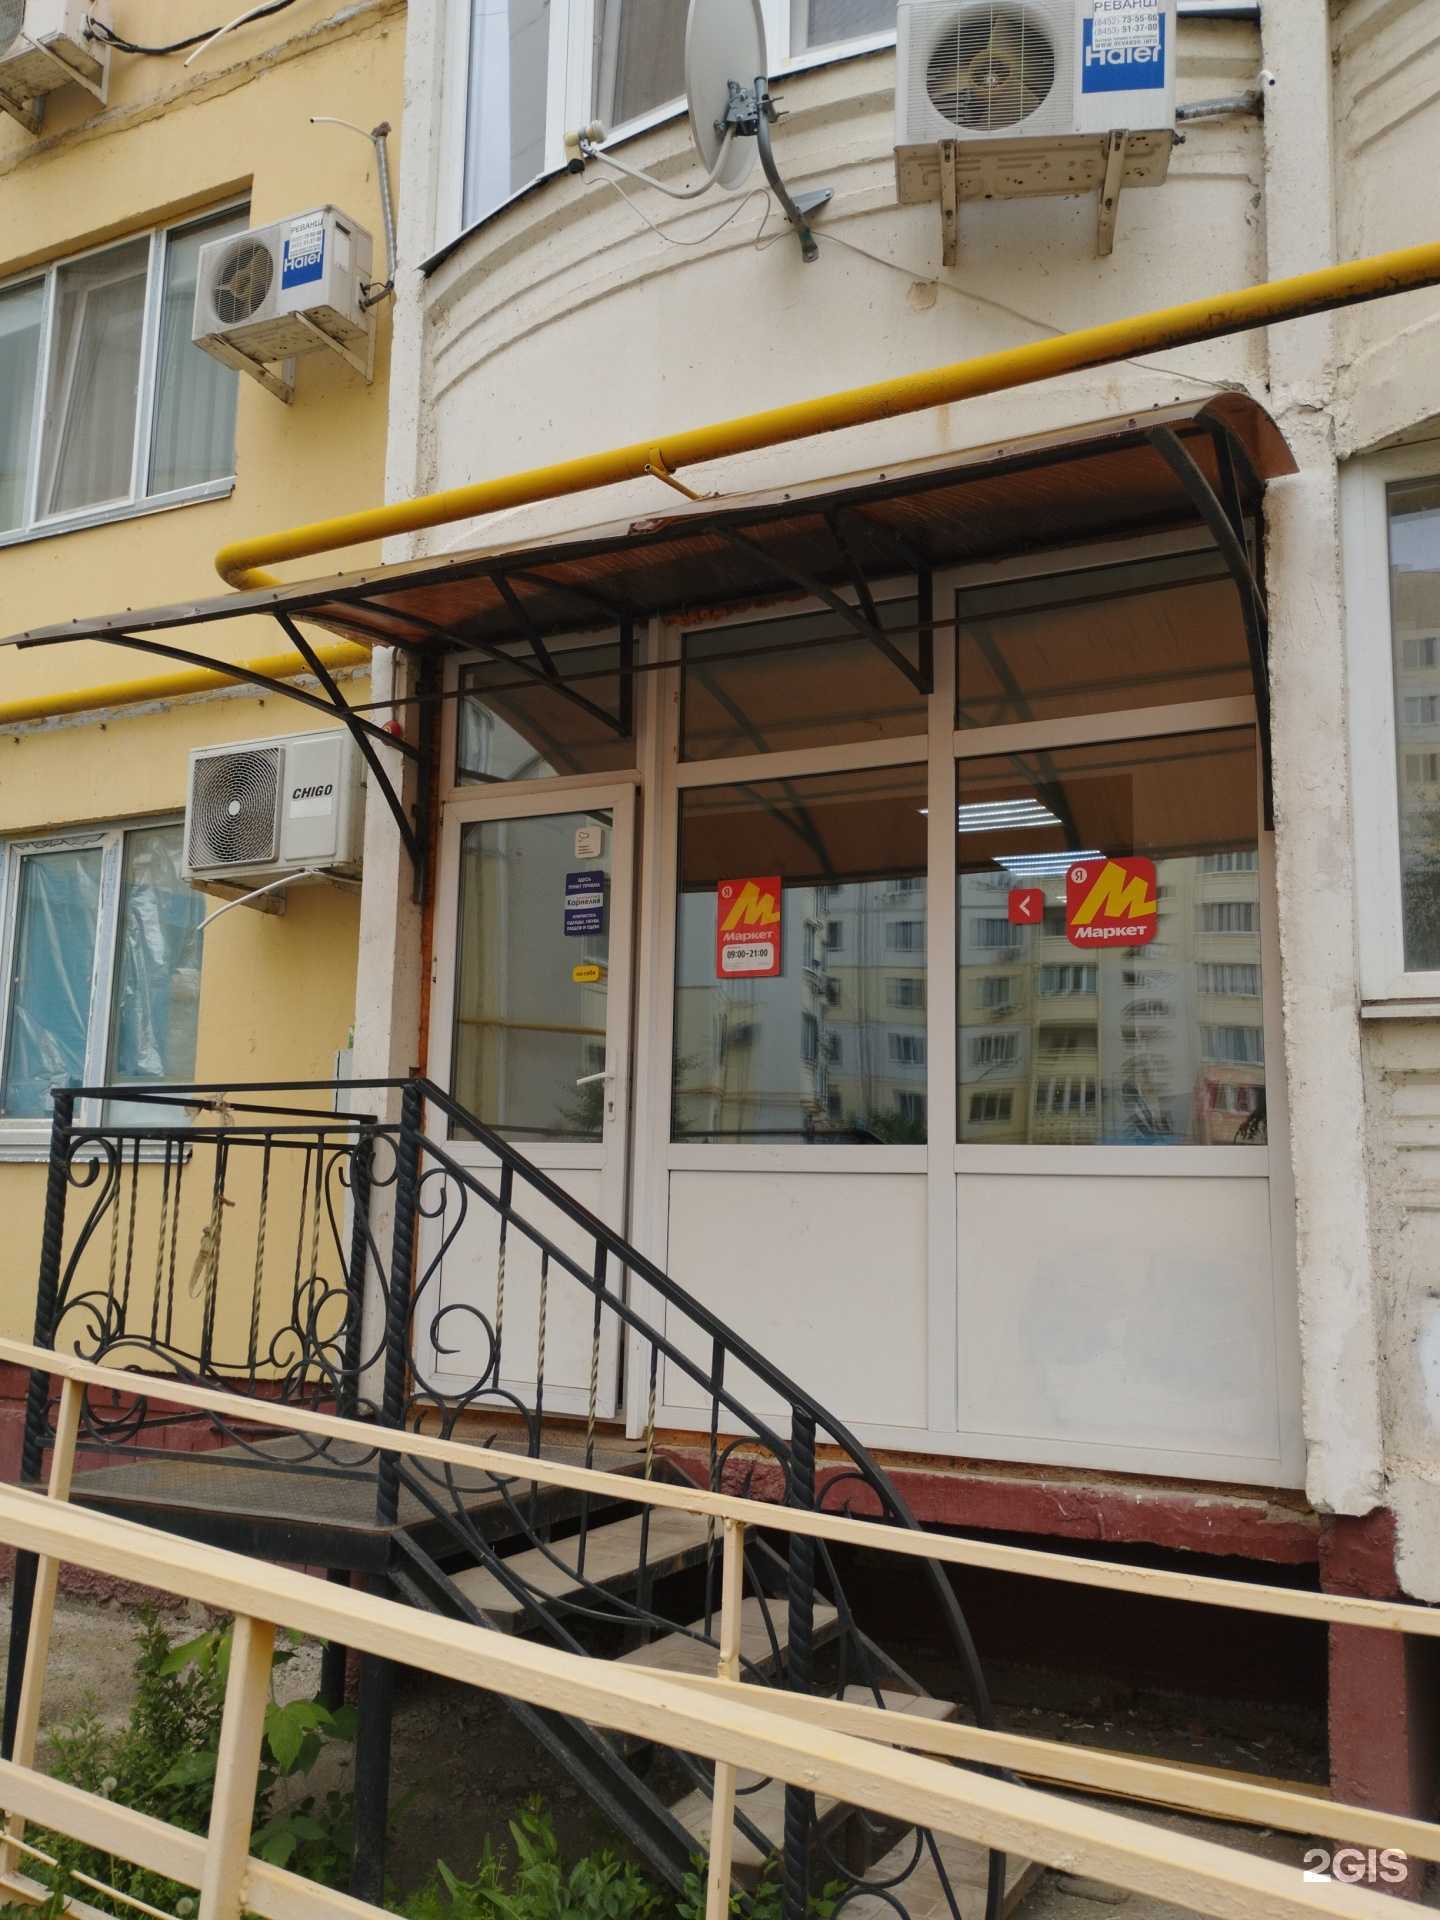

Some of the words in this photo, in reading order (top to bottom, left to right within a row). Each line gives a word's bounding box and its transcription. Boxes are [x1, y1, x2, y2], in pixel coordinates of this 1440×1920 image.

[1085, 46, 1161, 67] Haier
[283, 252, 322, 273] Haier
[292, 784, 333, 800] CHIGO
[722, 930, 774, 943] Маркет
[1074, 925, 1147, 940] Маркет
[726, 948, 768, 959] 09:00-21:00
